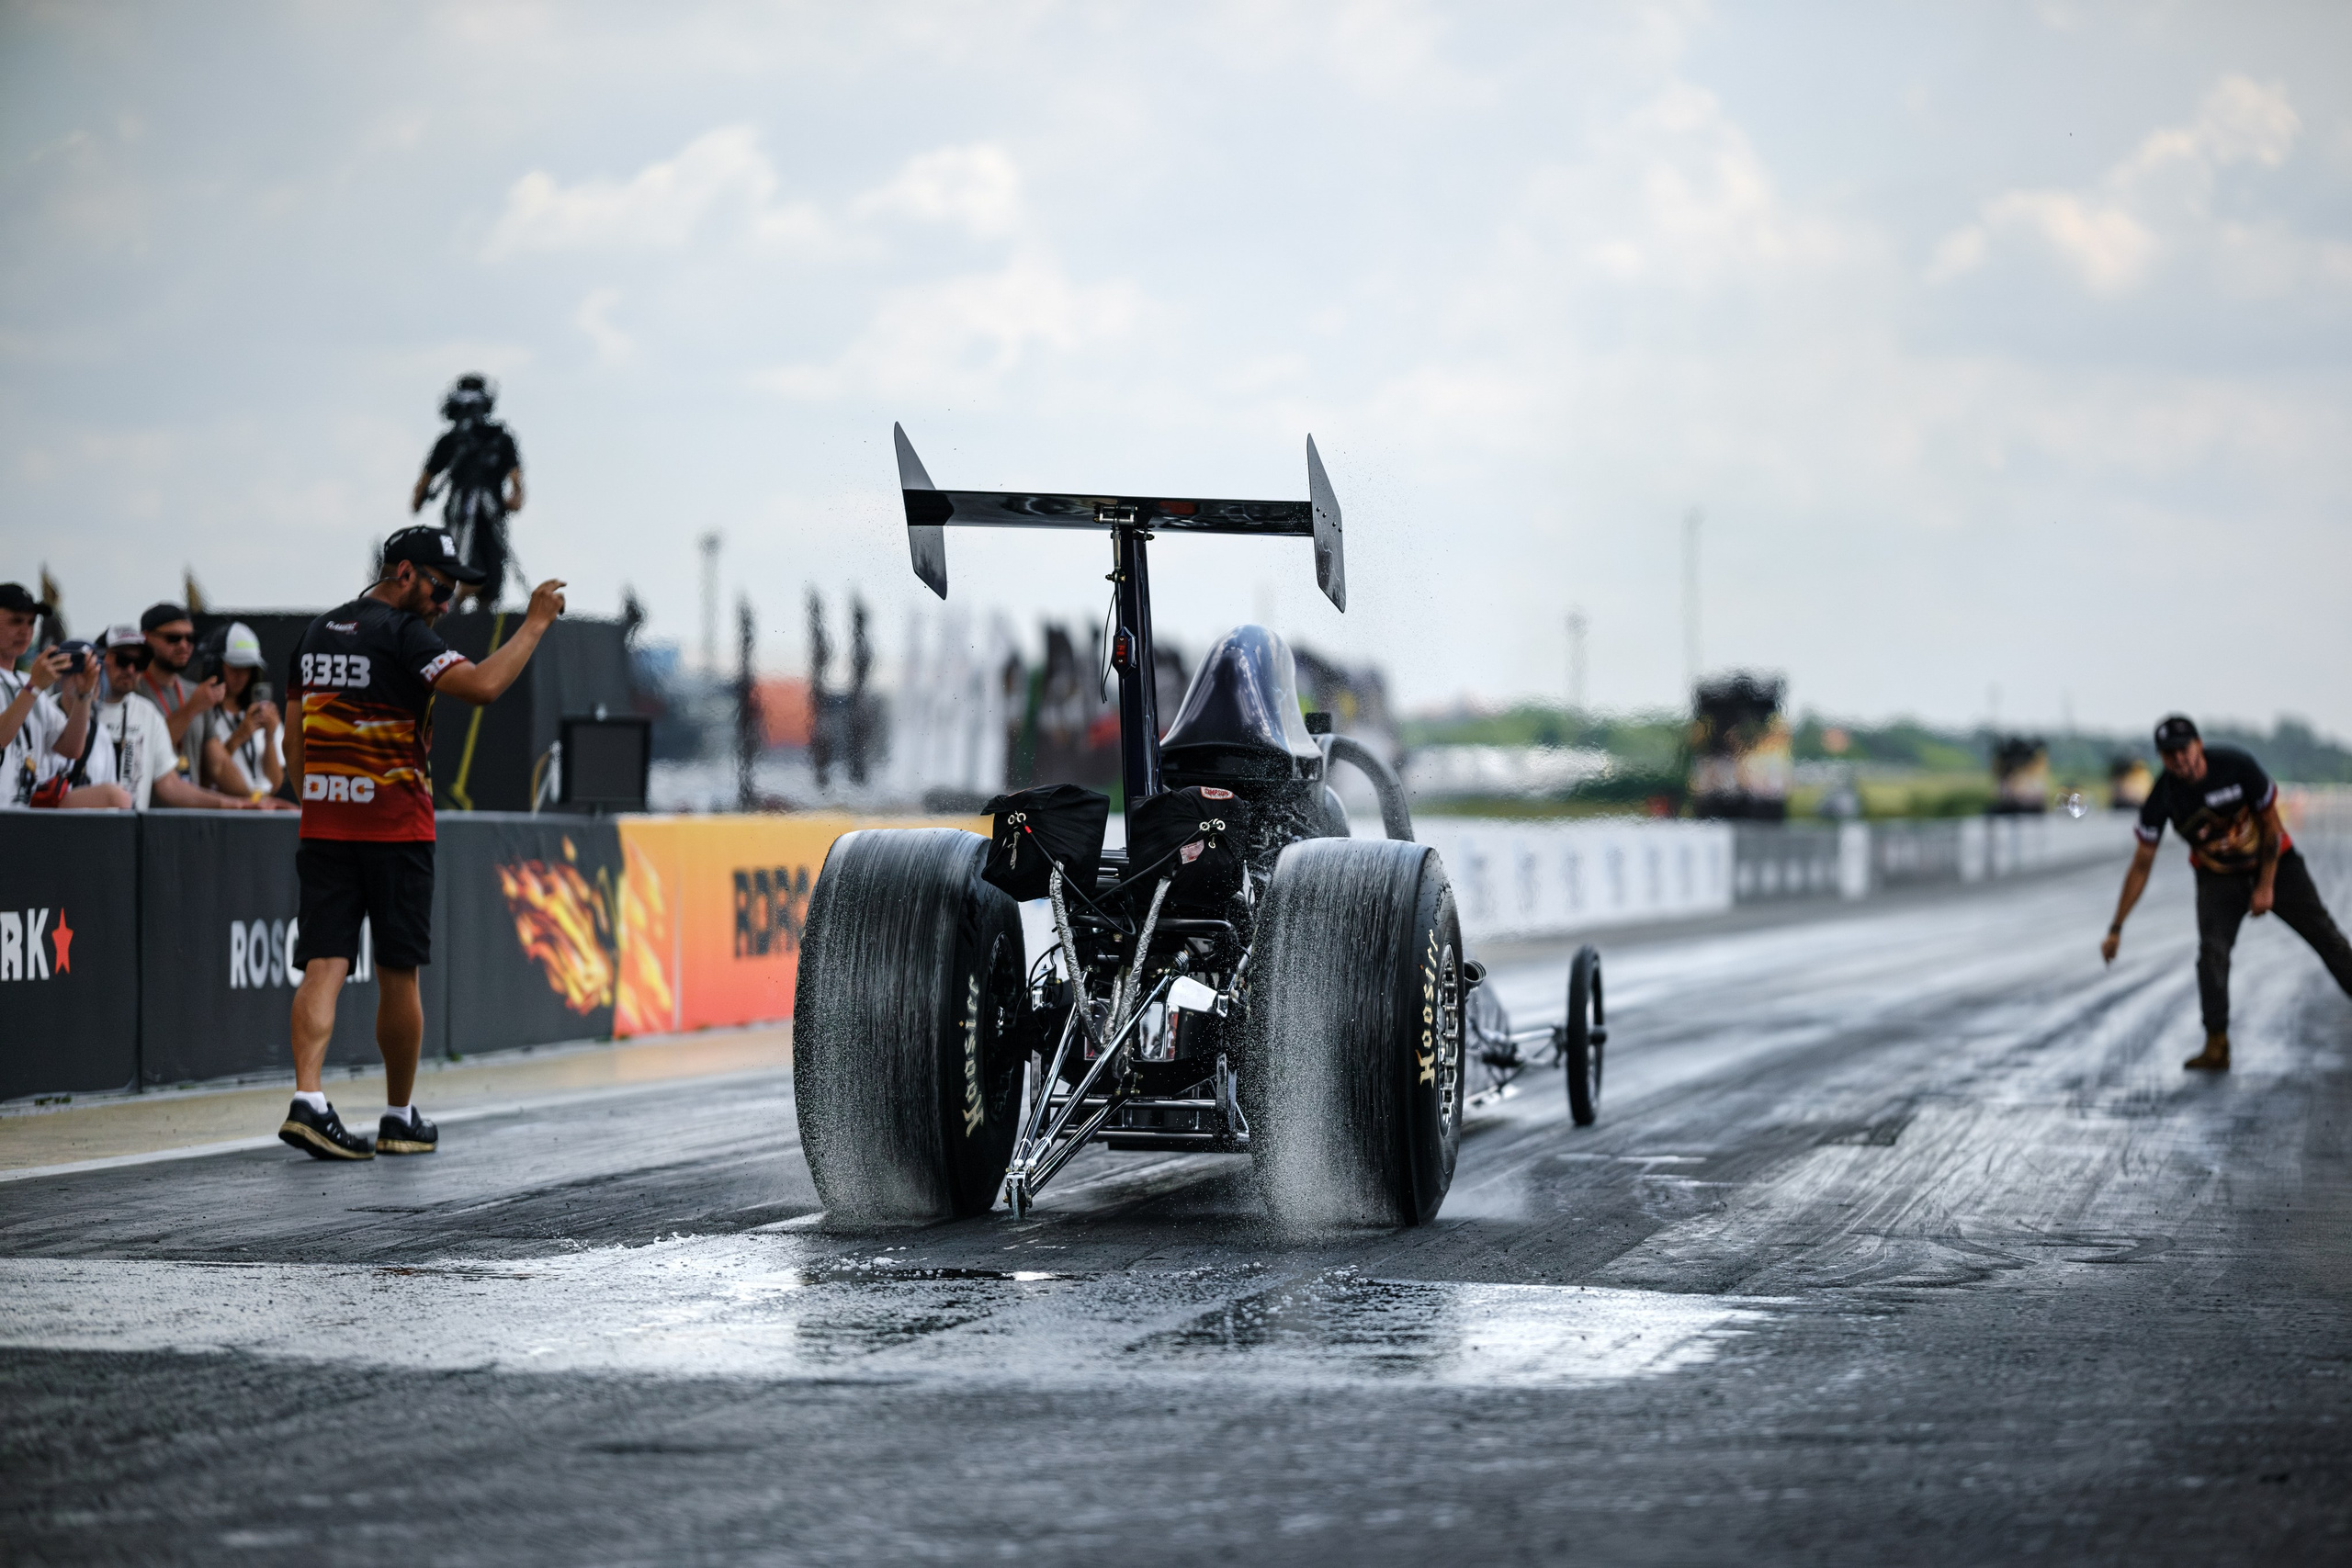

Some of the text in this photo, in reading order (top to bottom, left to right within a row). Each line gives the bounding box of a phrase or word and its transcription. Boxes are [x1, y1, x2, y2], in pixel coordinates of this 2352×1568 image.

[300, 653, 371, 687] 8333
[303, 773, 375, 804] DRC
[1204, 787, 1229, 796] SIMPSON
[1417, 929, 1438, 1089] Hoosier
[958, 974, 984, 1138] Hoosier
